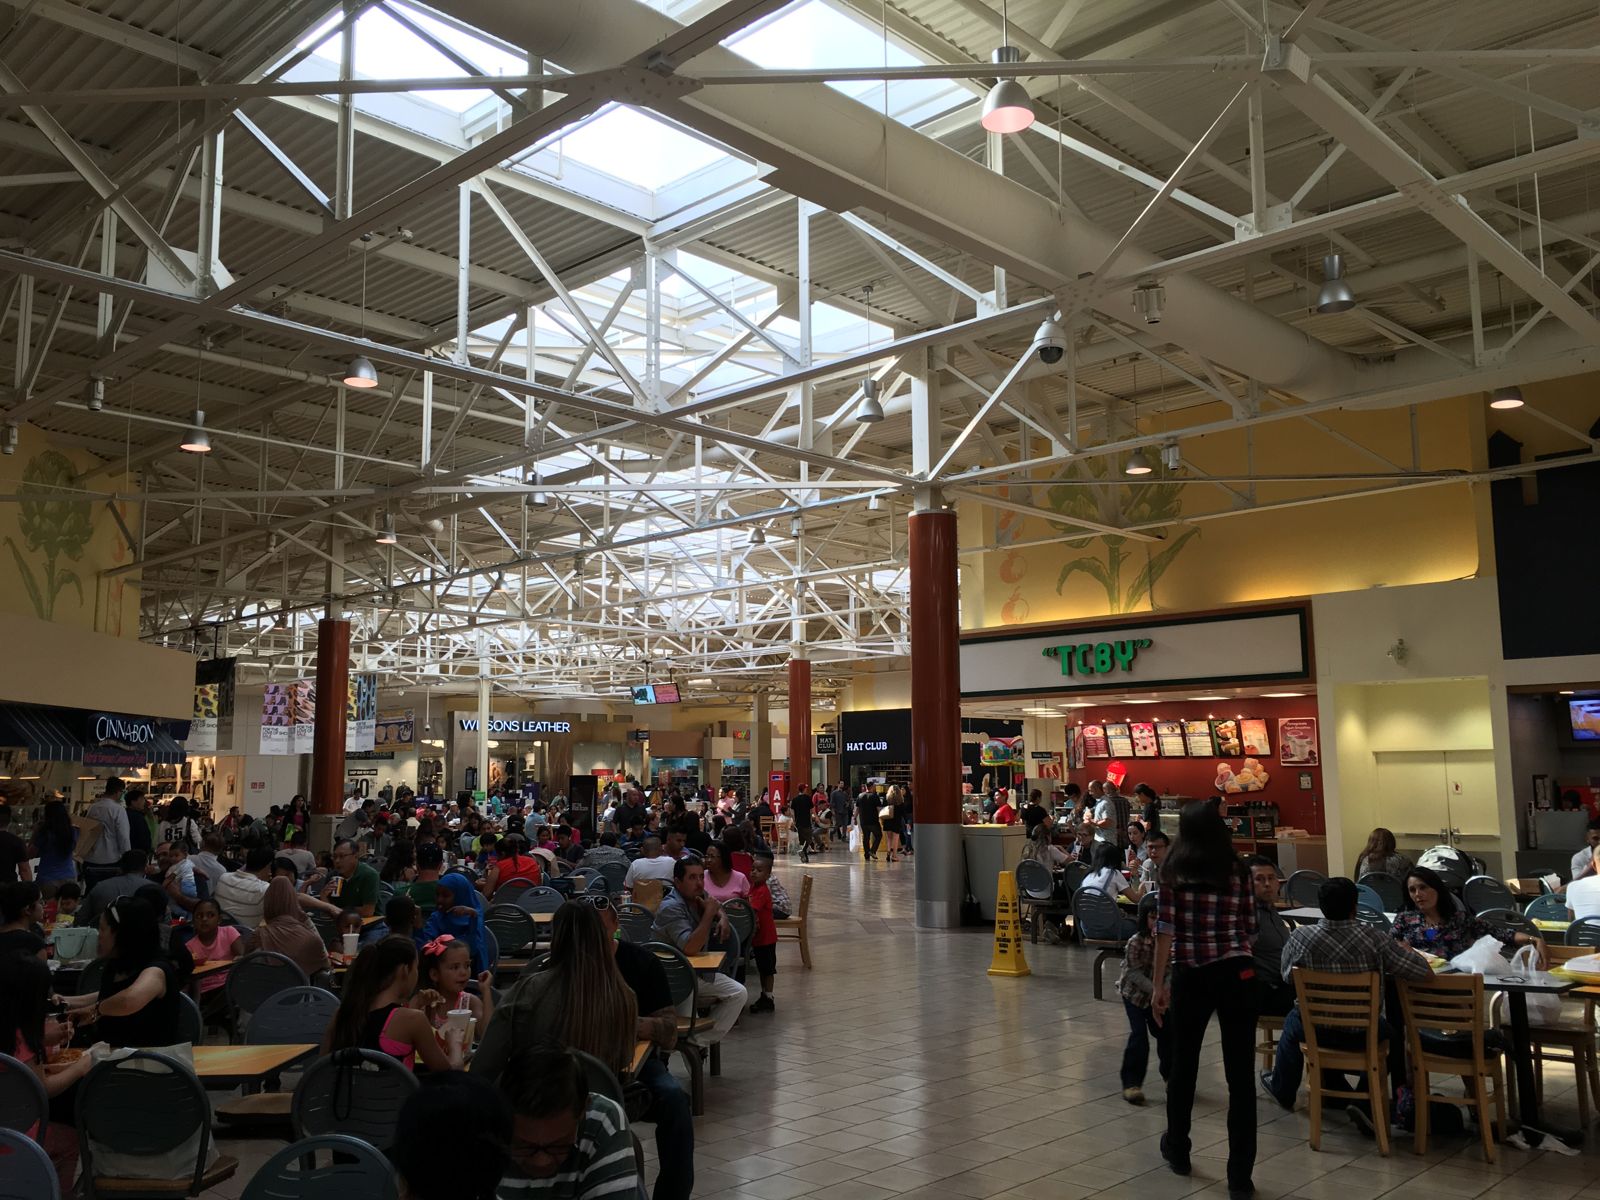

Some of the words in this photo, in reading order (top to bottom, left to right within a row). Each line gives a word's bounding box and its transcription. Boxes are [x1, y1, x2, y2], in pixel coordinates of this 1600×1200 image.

[96, 716, 155, 743] CINNABON
[462, 720, 519, 731] WISONS
[522, 721, 570, 733] LEATHER
[846, 742, 864, 751] HAT
[864, 741, 888, 751] CLUB
[165, 828, 183, 841] 85
